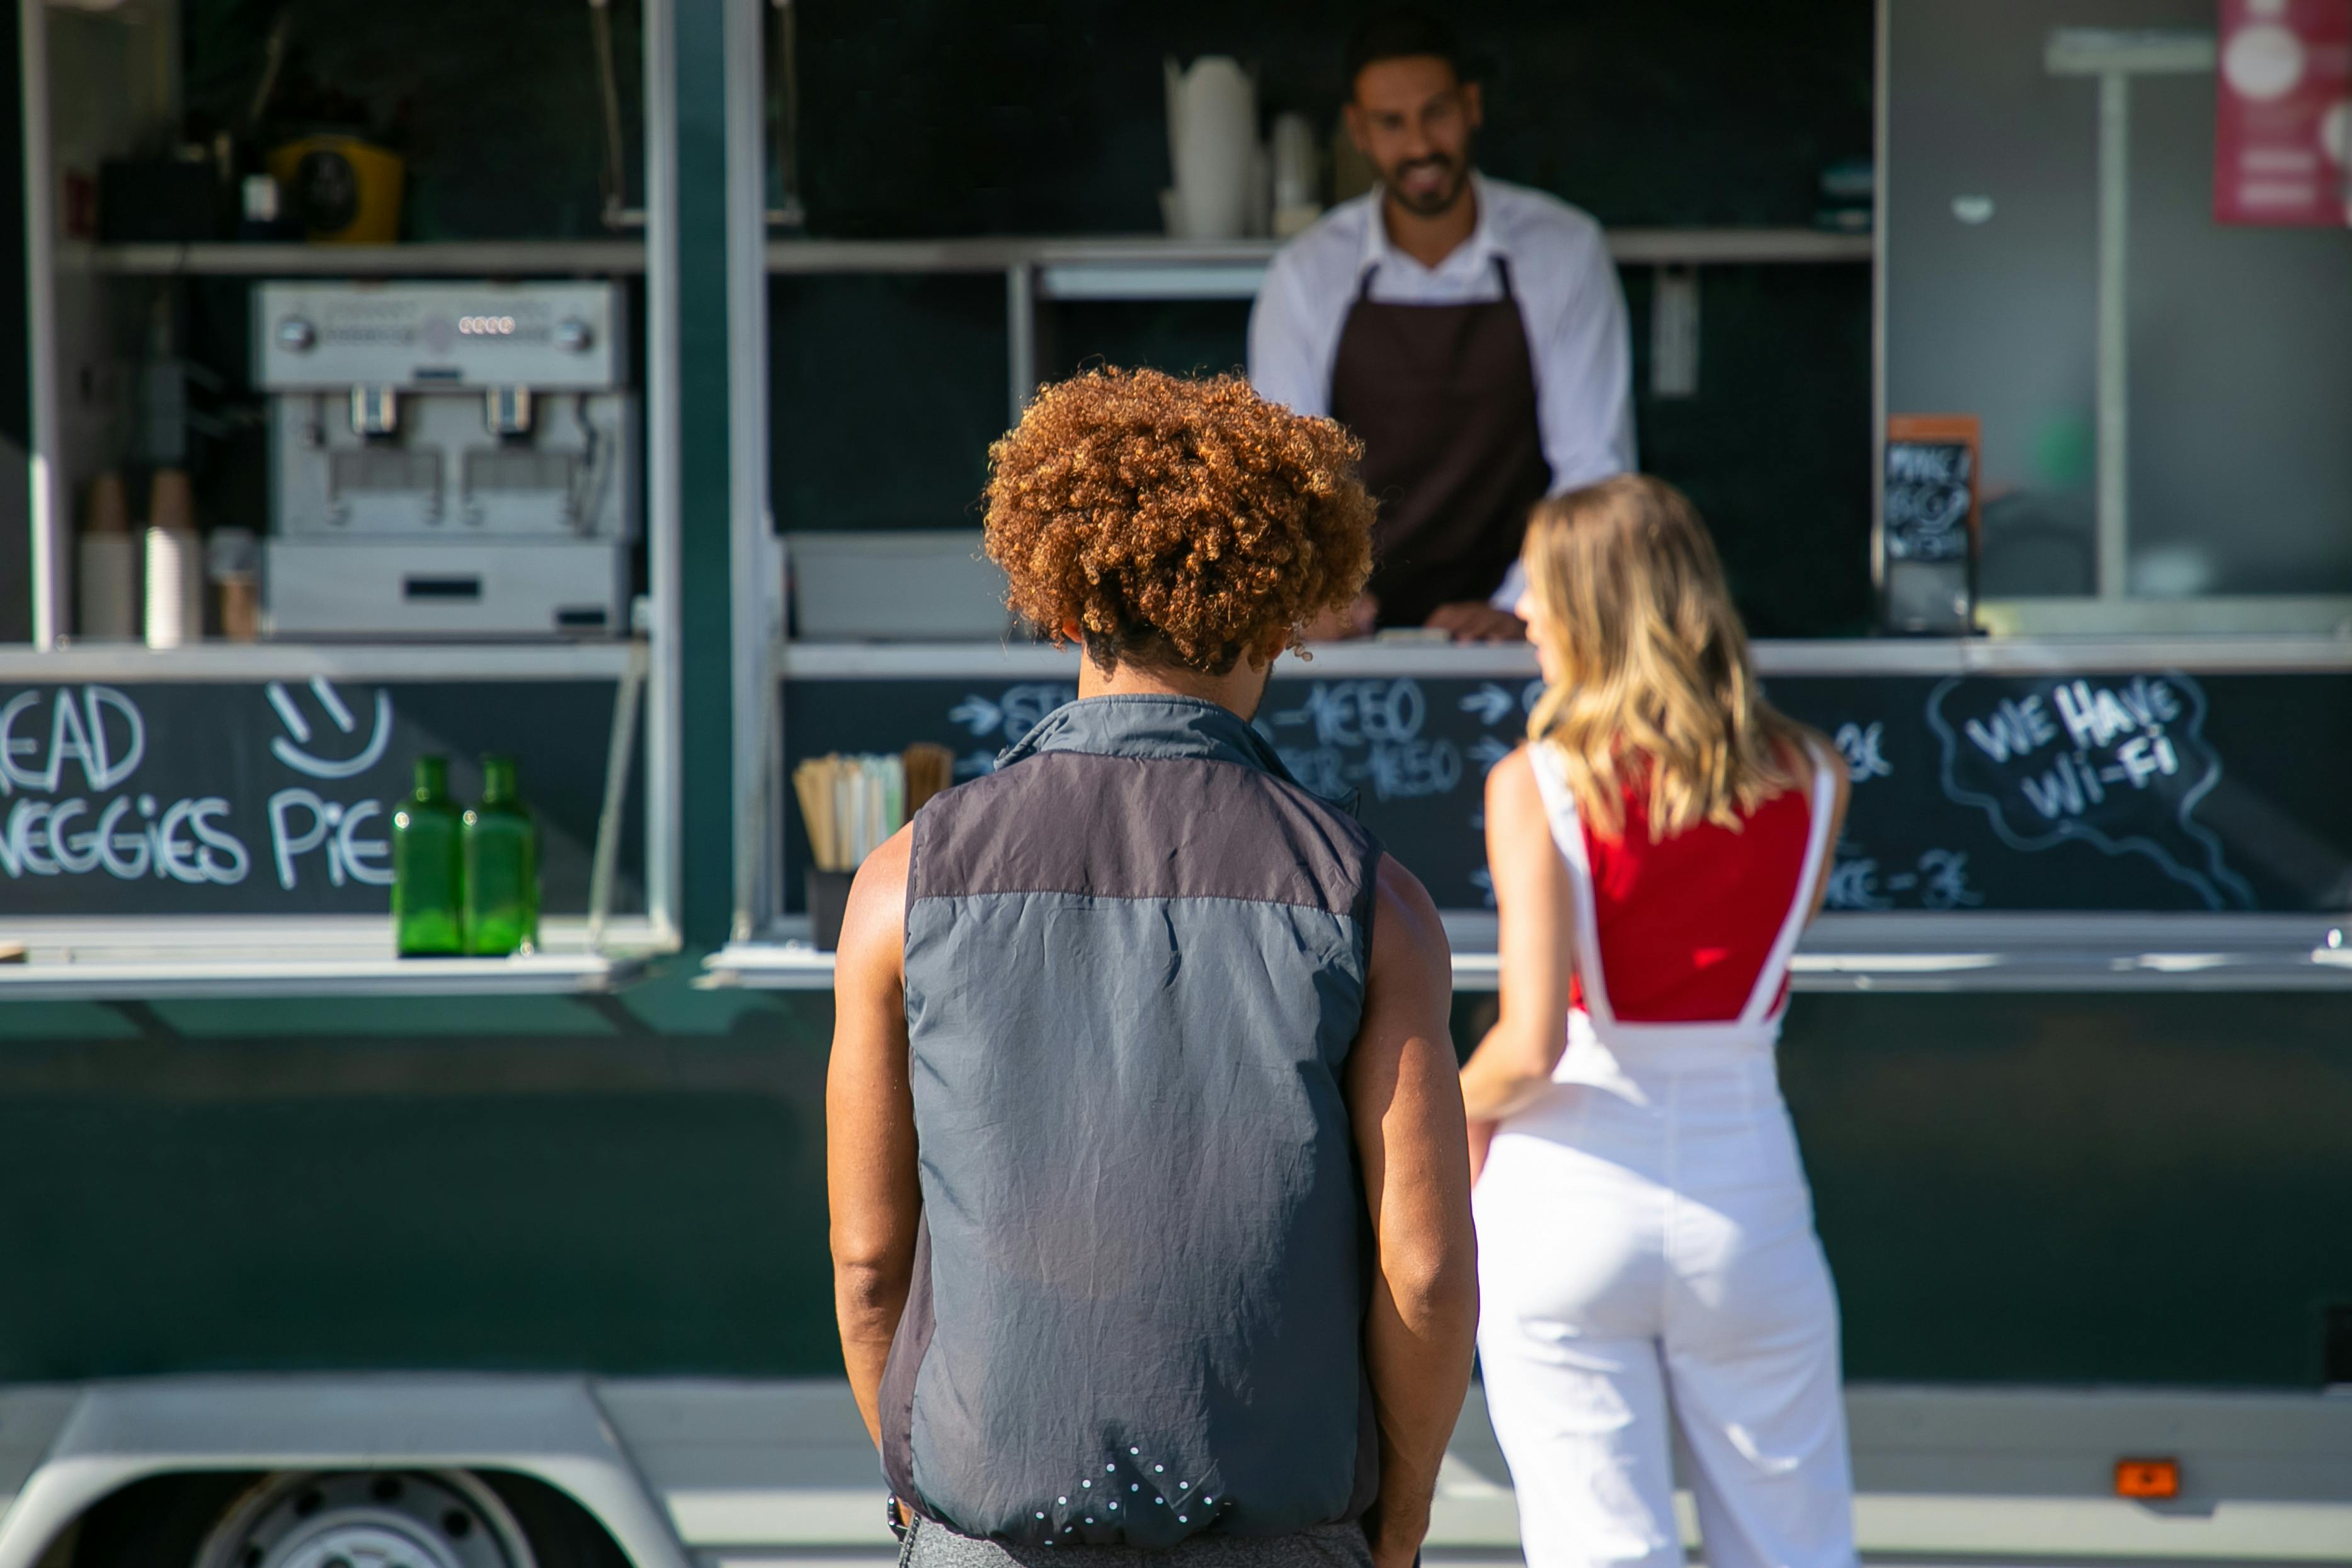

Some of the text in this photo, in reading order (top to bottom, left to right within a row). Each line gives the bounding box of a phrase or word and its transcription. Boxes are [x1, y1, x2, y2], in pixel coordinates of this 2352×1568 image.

[0, 683, 146, 794] EAD
[1964, 674, 2182, 763] WE HAVE
